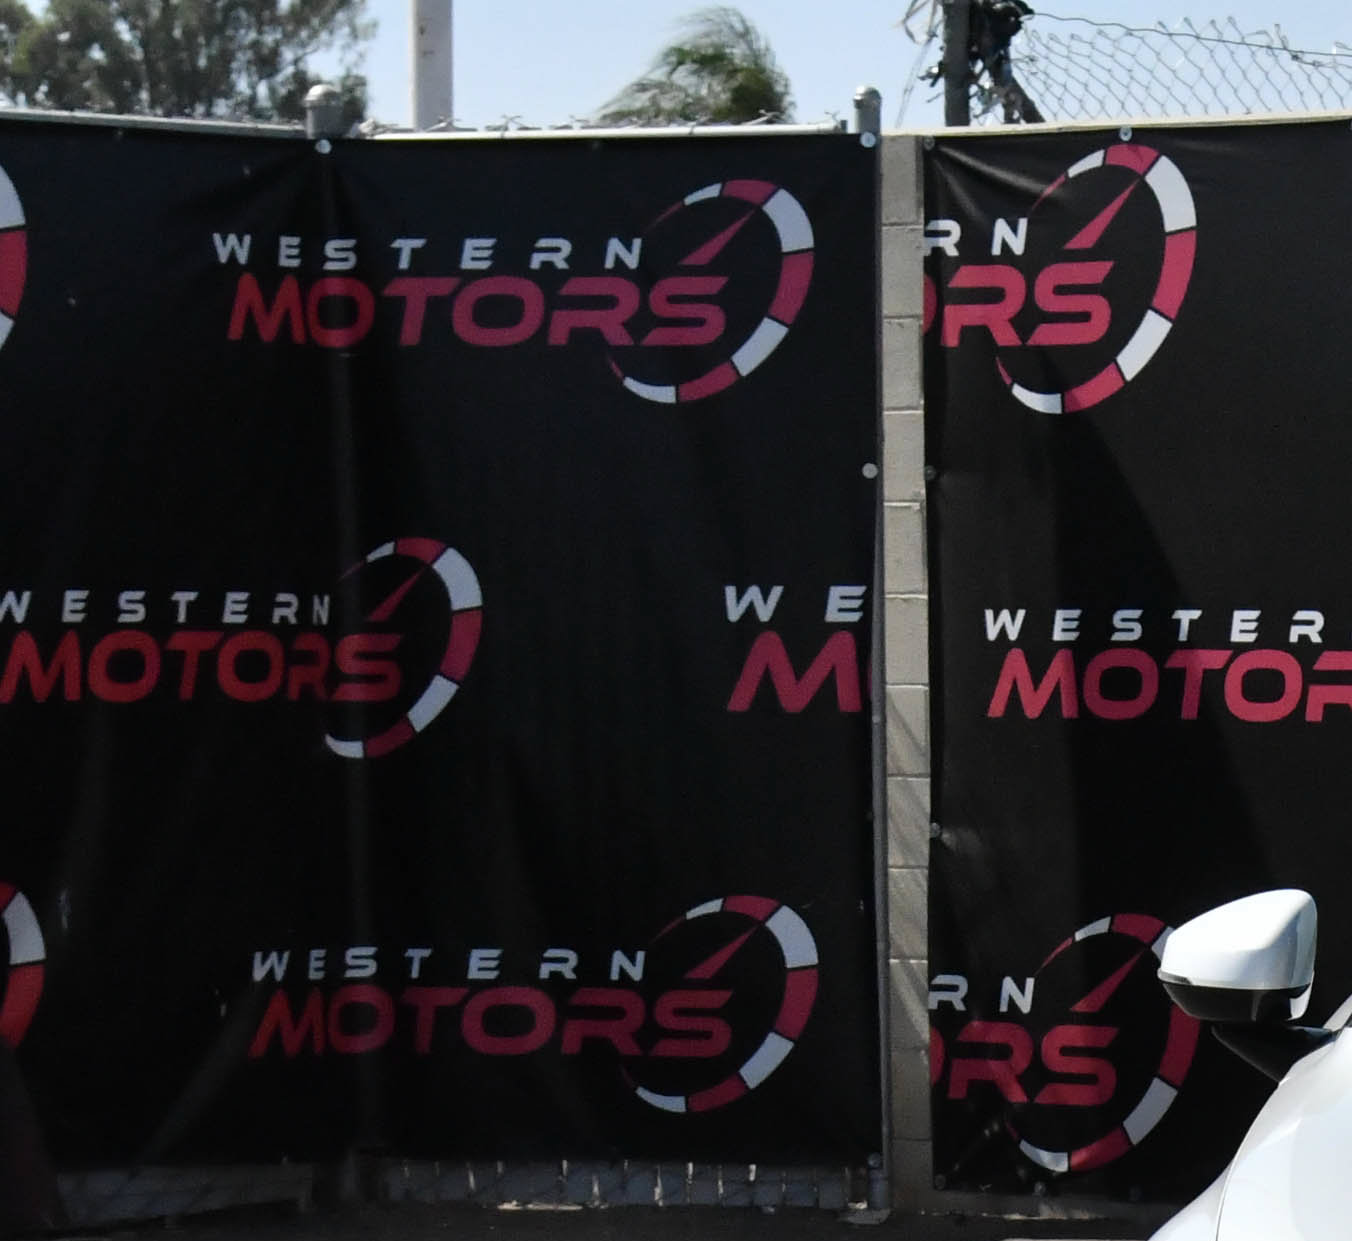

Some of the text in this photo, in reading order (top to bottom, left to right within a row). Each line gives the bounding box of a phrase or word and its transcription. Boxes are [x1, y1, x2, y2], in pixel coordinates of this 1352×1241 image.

[213, 233, 641, 270] WESTERN
[229, 274, 726, 347] MOTORS
[924, 262, 1112, 347] RS
[2, 630, 402, 704] MOTORS
[253, 947, 645, 981] WESTERN
[251, 984, 731, 1056] MOTORS
[931, 1021, 1115, 1105] RS
